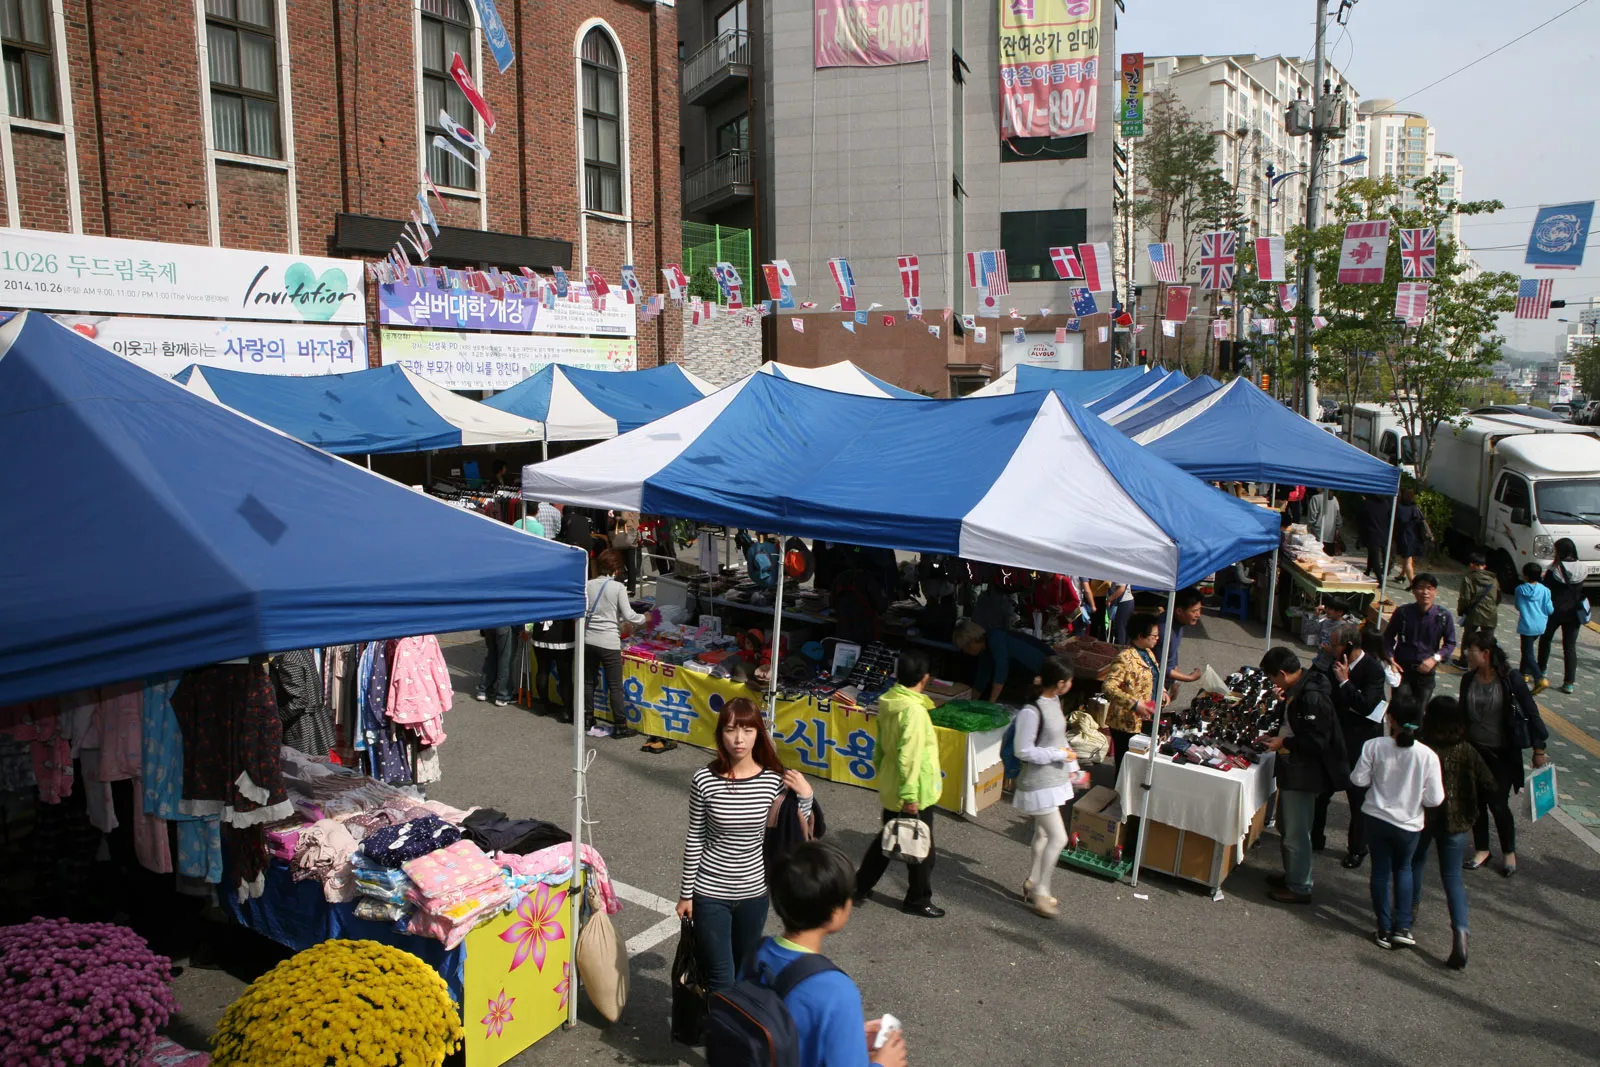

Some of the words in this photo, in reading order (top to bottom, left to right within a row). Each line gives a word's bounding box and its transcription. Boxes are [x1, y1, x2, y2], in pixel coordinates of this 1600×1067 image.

[1000, 32, 1061, 58] (잔여상가
[1067, 26, 1099, 52] 임대)
[1002, 86, 1097, 134] 467-8924
[2, 250, 58, 274] 1026
[67, 255, 177, 285] 두드림축제
[4, 280, 62, 293] 2014.10.26
[83, 287, 95, 295] AM
[117, 289, 136, 298] 11:00
[142, 290, 153, 298] PM
[243, 265, 357, 308] Invitation
[410, 292, 486, 322] 실버대학
[489, 298, 524, 324] 개강
[113, 341, 157, 357] 이웃과
[161, 341, 216, 358] 함께하는
[223, 337, 286, 363] 사랑의
[297, 339, 354, 363] 바자회
[449, 342, 458, 350] PD
[426, 360, 453, 375] 부모가
[456, 361, 473, 374] 아이
[476, 361, 493, 376] 뇌를
[496, 362, 520, 376] 망친다
